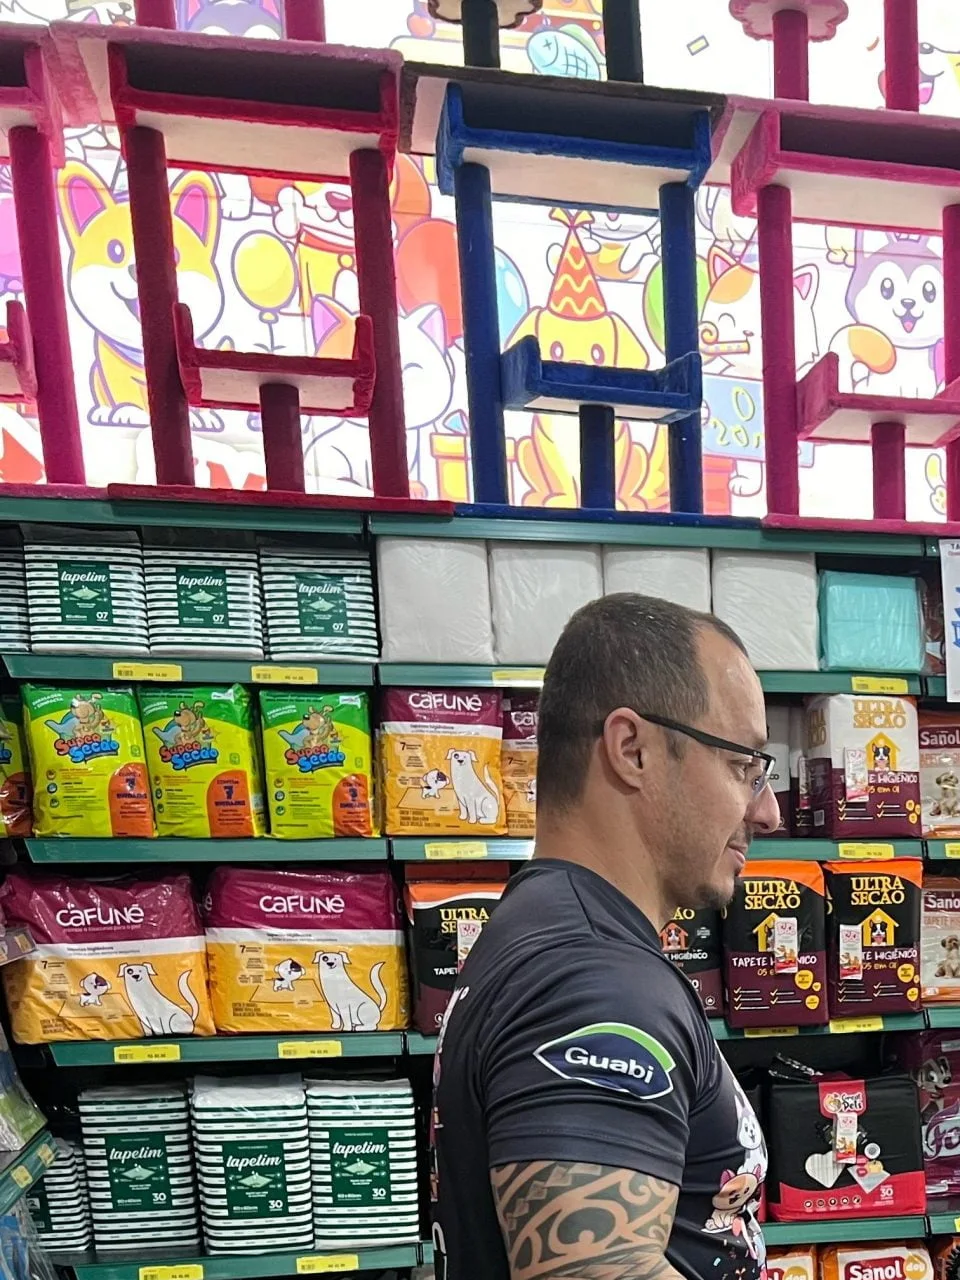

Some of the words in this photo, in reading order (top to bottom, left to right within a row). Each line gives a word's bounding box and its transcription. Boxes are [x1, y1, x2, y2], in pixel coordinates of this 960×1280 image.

[61, 570, 108, 585] tapetim
[179, 575, 223, 590] tapetim
[299, 583, 342, 596] tapetim
[96, 611, 108, 619] 07
[213, 614, 224, 622] 07
[332, 623, 344, 631] 07
[744, 881, 801, 895] ULTRA
[851, 876, 905, 890] ULTRA
[440, 908, 490, 921] ULTRA
[874, 948, 918, 961] HIGIÊNICO
[732, 957, 769, 968] TAPETE
[564, 1046, 655, 1085] Guabi
[109, 1146, 164, 1164] tapetim
[332, 1141, 387, 1159] tapetim
[226, 1154, 282, 1171] tapetim
[152, 1192, 166, 1202] 30
[372, 1188, 386, 1197] 30
[880, 1188, 893, 1197] 30
[268, 1200, 283, 1209] 30
[907, 1262, 927, 1273] dog
